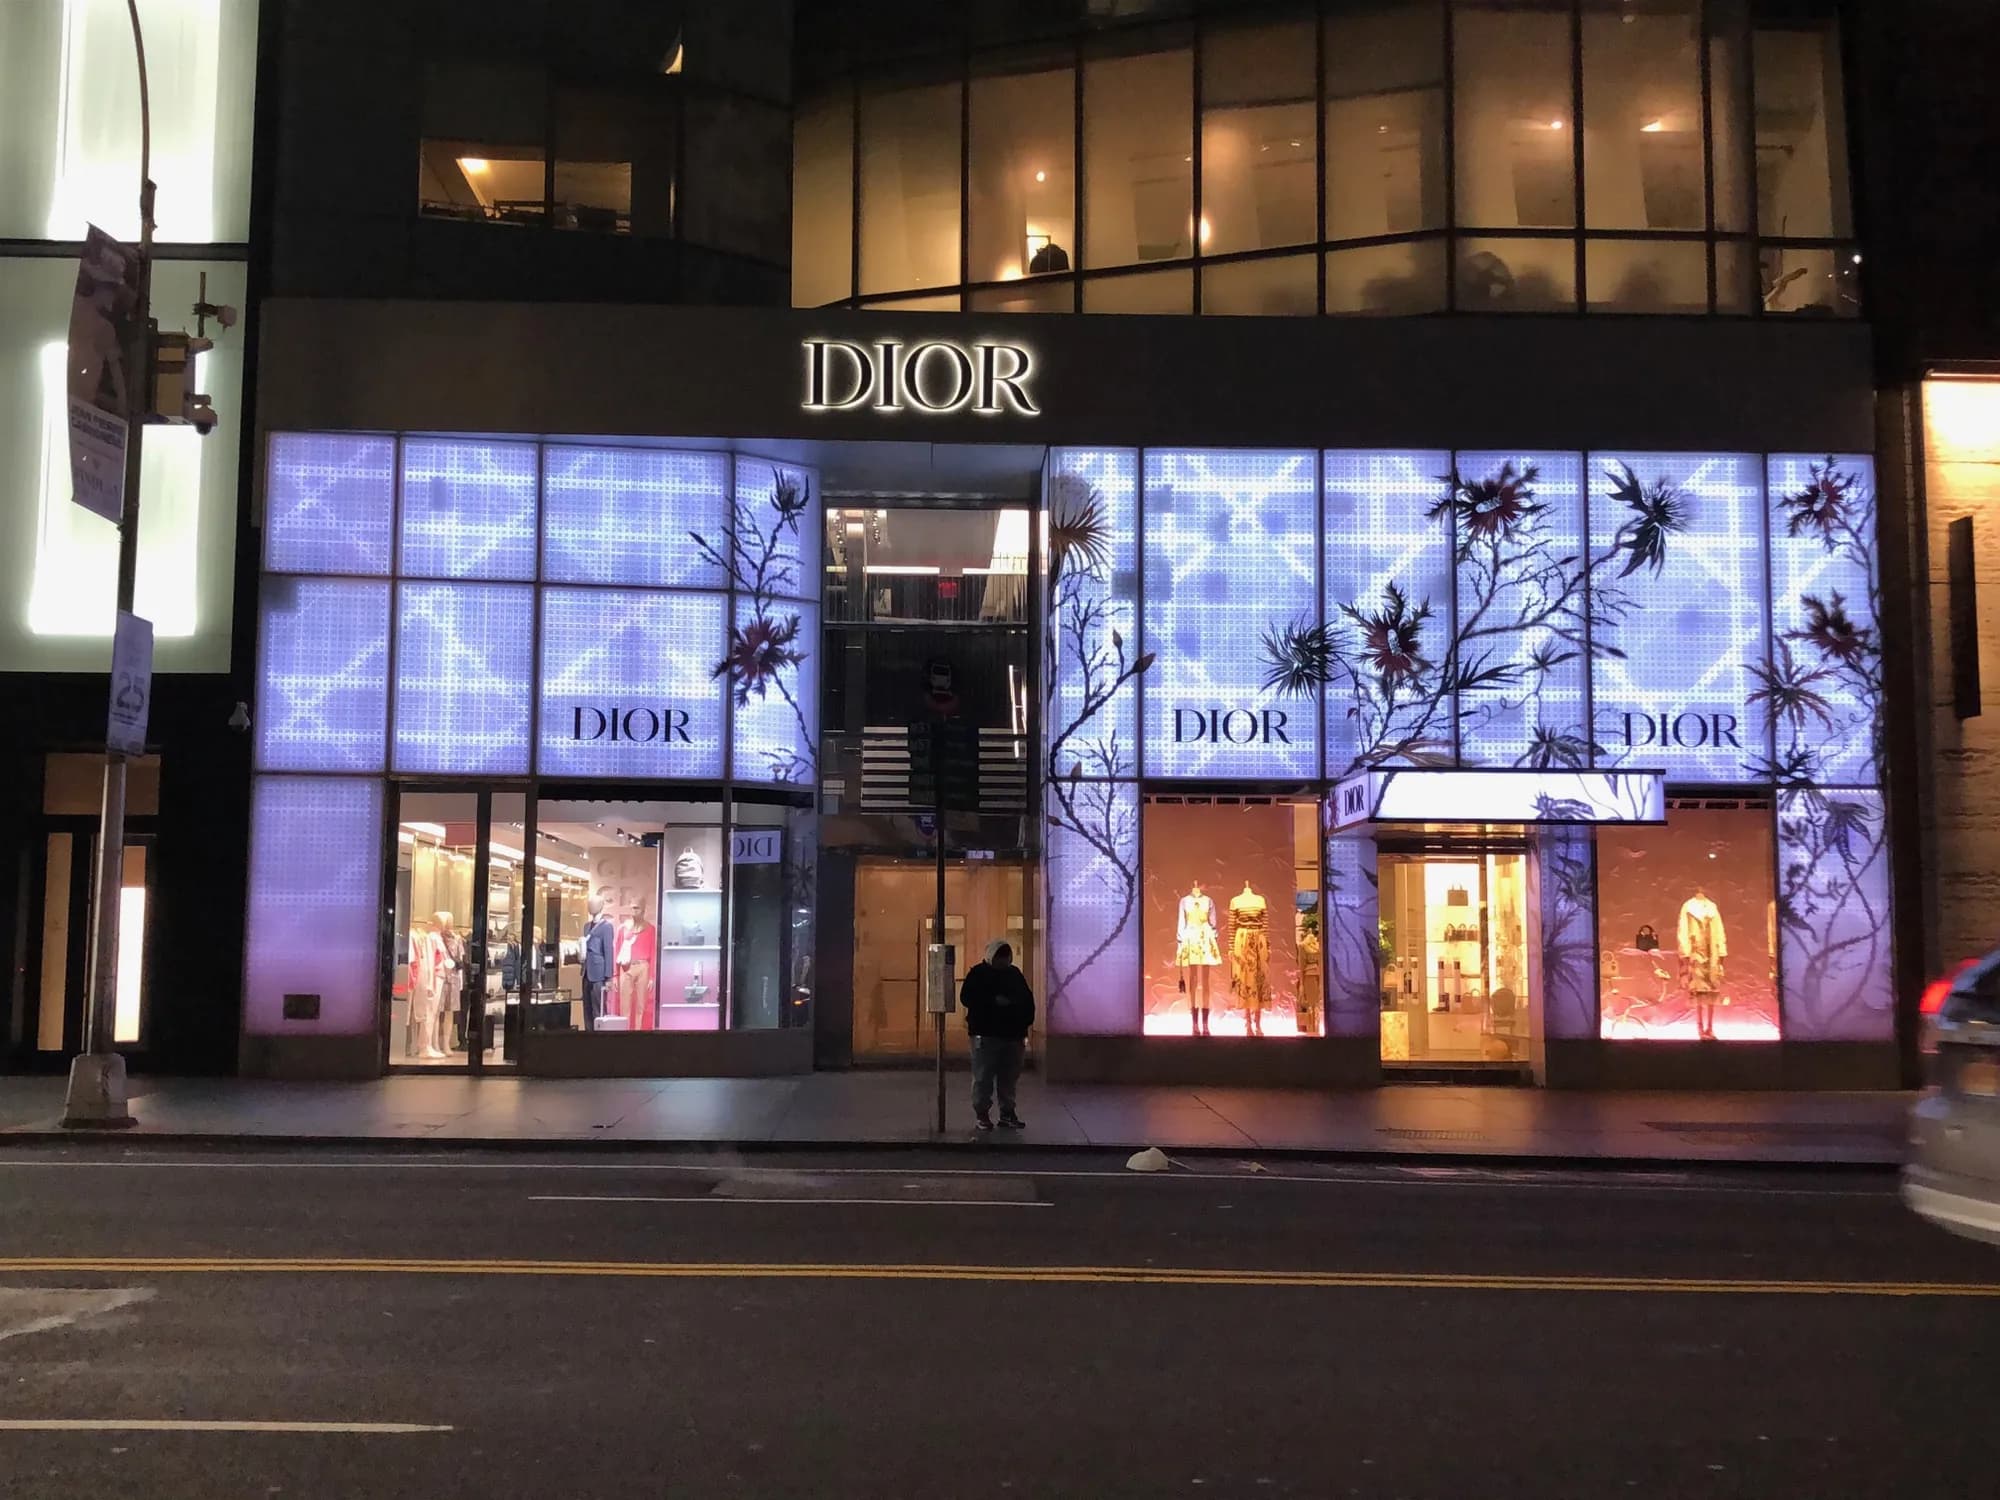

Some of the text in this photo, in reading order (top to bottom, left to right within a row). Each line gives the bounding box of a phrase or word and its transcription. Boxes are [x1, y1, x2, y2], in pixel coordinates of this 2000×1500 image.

[802, 342, 1040, 414] DIOR
[571, 706, 693, 744] DIOR
[1172, 708, 1292, 744] DIOR
[1621, 712, 1743, 748] DIOR
[1344, 784, 1365, 816] DIOR
